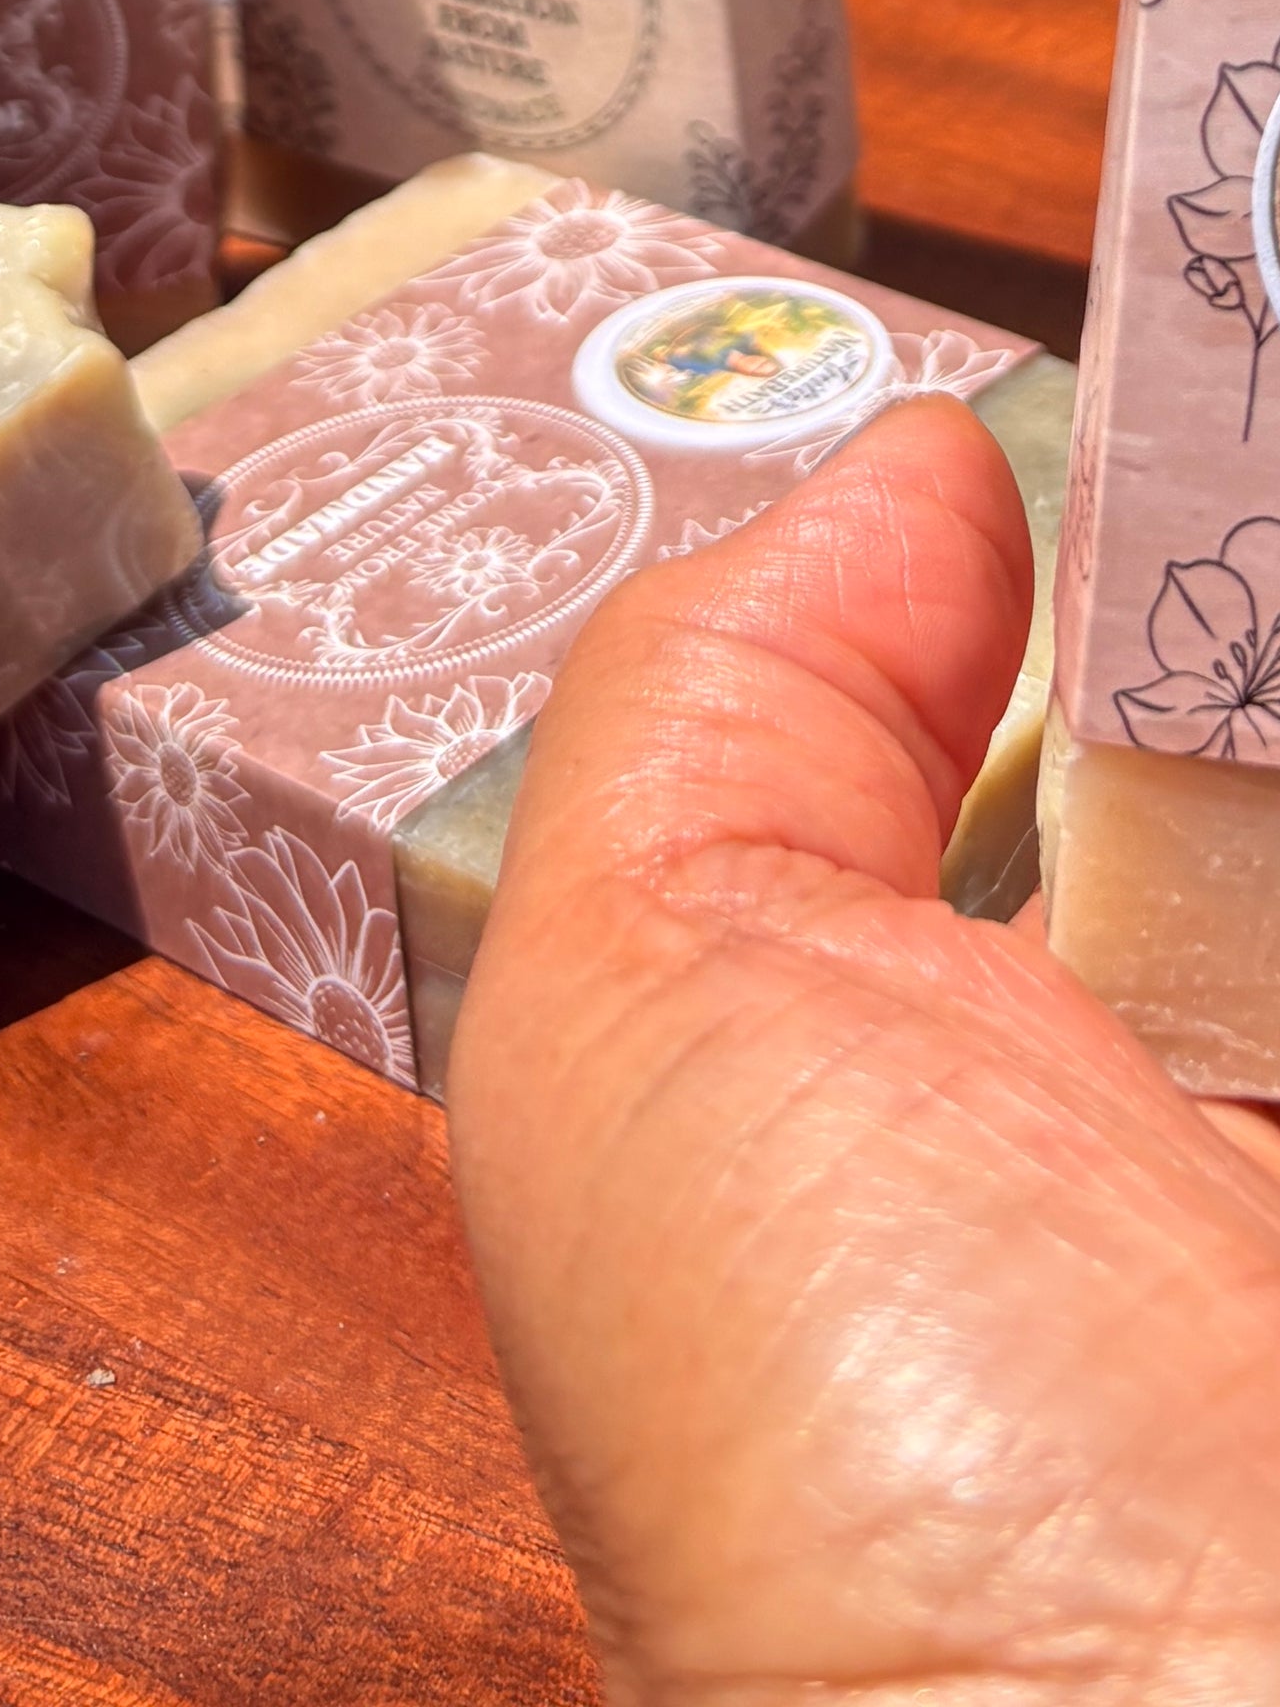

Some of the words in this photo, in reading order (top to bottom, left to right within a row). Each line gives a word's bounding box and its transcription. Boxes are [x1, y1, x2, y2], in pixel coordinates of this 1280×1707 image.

[234, 436, 458, 582] HANDMADE
[324, 483, 449, 562] NATURE
[410, 480, 507, 538] COME
[331, 535, 423, 591] FROM
